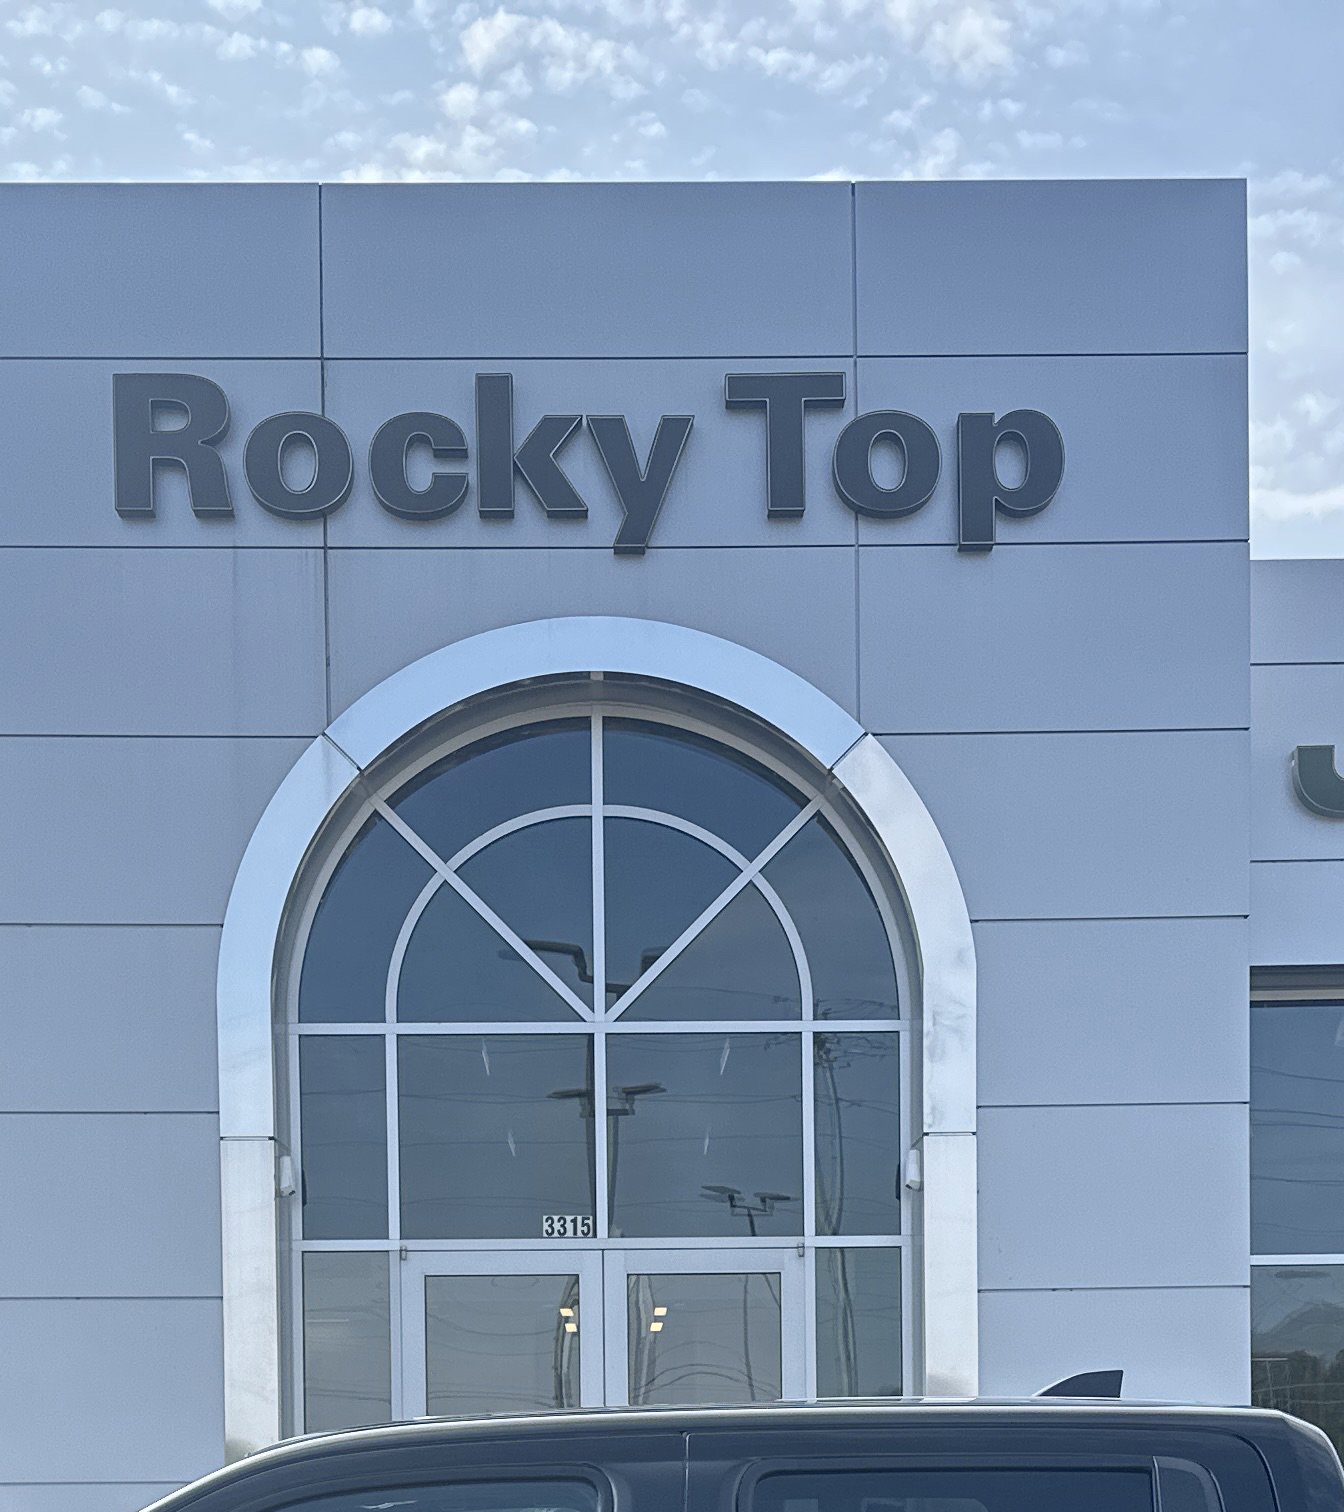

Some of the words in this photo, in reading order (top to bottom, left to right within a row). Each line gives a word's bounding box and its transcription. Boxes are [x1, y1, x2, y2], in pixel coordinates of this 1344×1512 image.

[112, 372, 695, 555] Rocky
[724, 371, 1066, 551] Top
[544, 1216, 591, 1237] 3315
